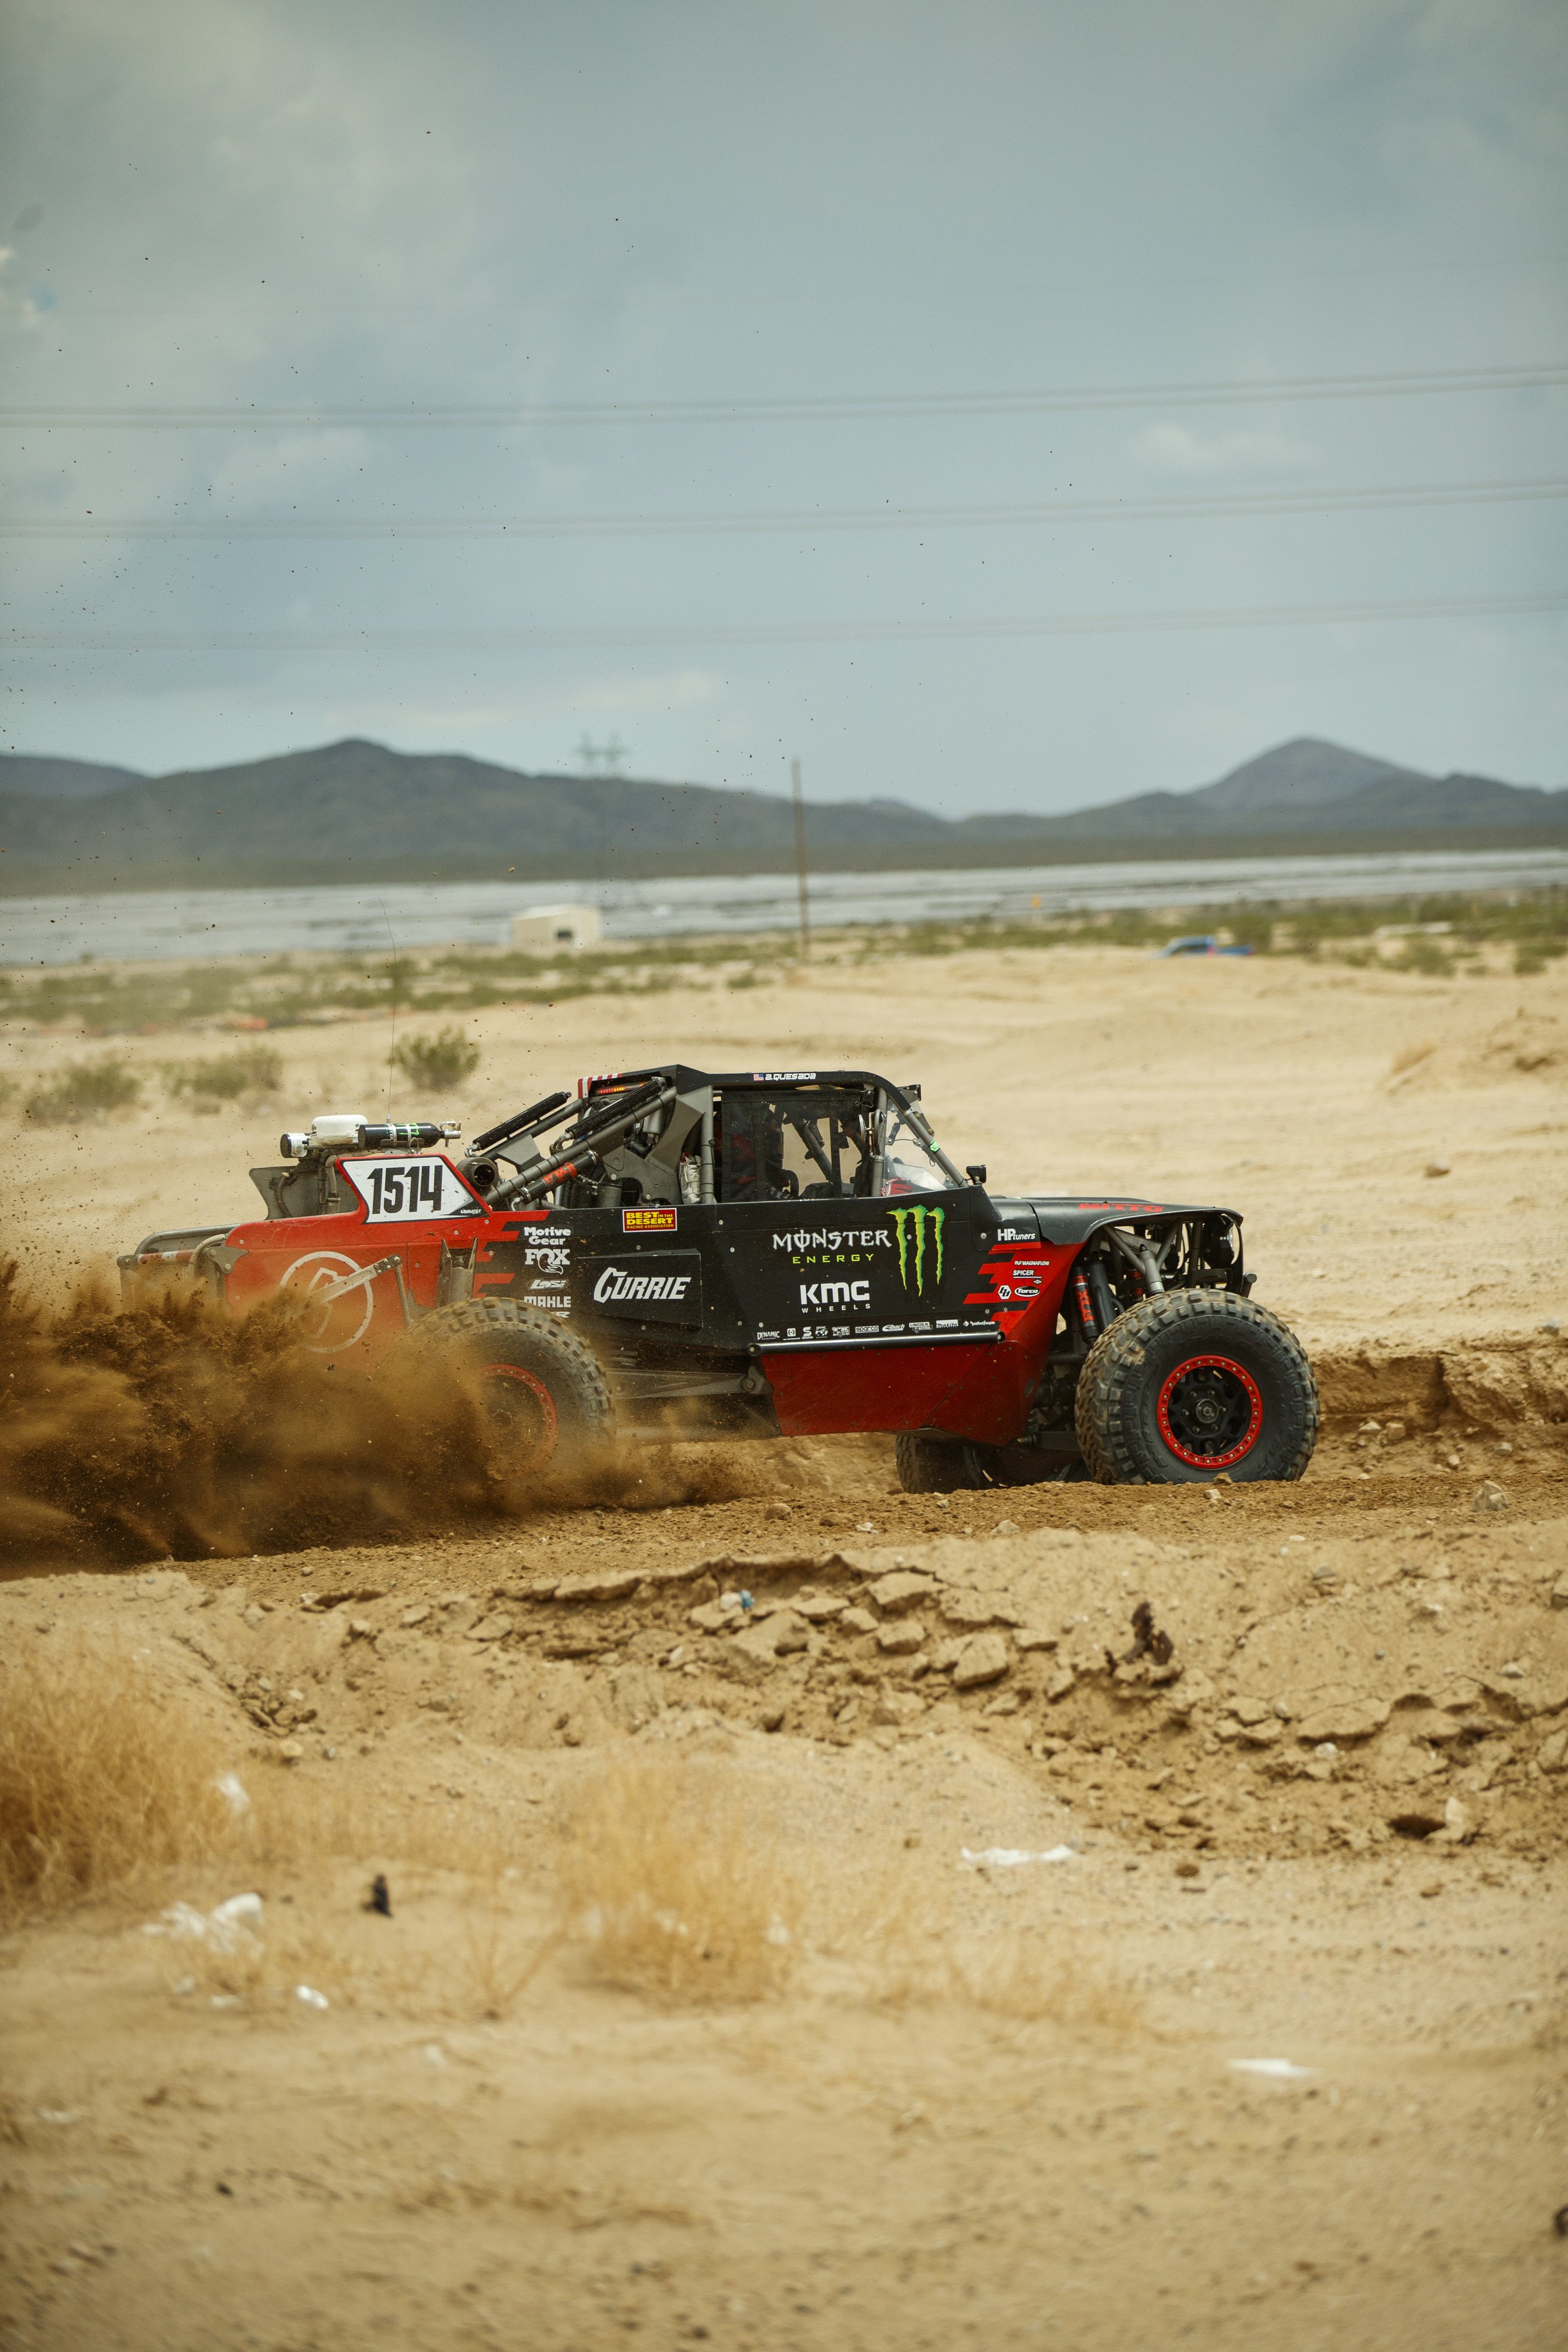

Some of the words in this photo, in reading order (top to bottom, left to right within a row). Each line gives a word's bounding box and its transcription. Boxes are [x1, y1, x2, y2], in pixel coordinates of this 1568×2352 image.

[367, 1165, 443, 1214] 1514
[1078, 1203, 1164, 1212] NITTO
[524, 1227, 571, 1236] Motive
[529, 1236, 566, 1245] Gear
[772, 1228, 892, 1253] MONSTER
[524, 1248, 570, 1274] FOX
[793, 1254, 874, 1264] ENERGY
[593, 1267, 691, 1303] CURRIE
[524, 1296, 571, 1308] MAHLE
[1076, 1287, 1094, 1323] FOX
[802, 1303, 871, 1313] WHEELS
[757, 1330, 780, 1340] DYNAMIC
